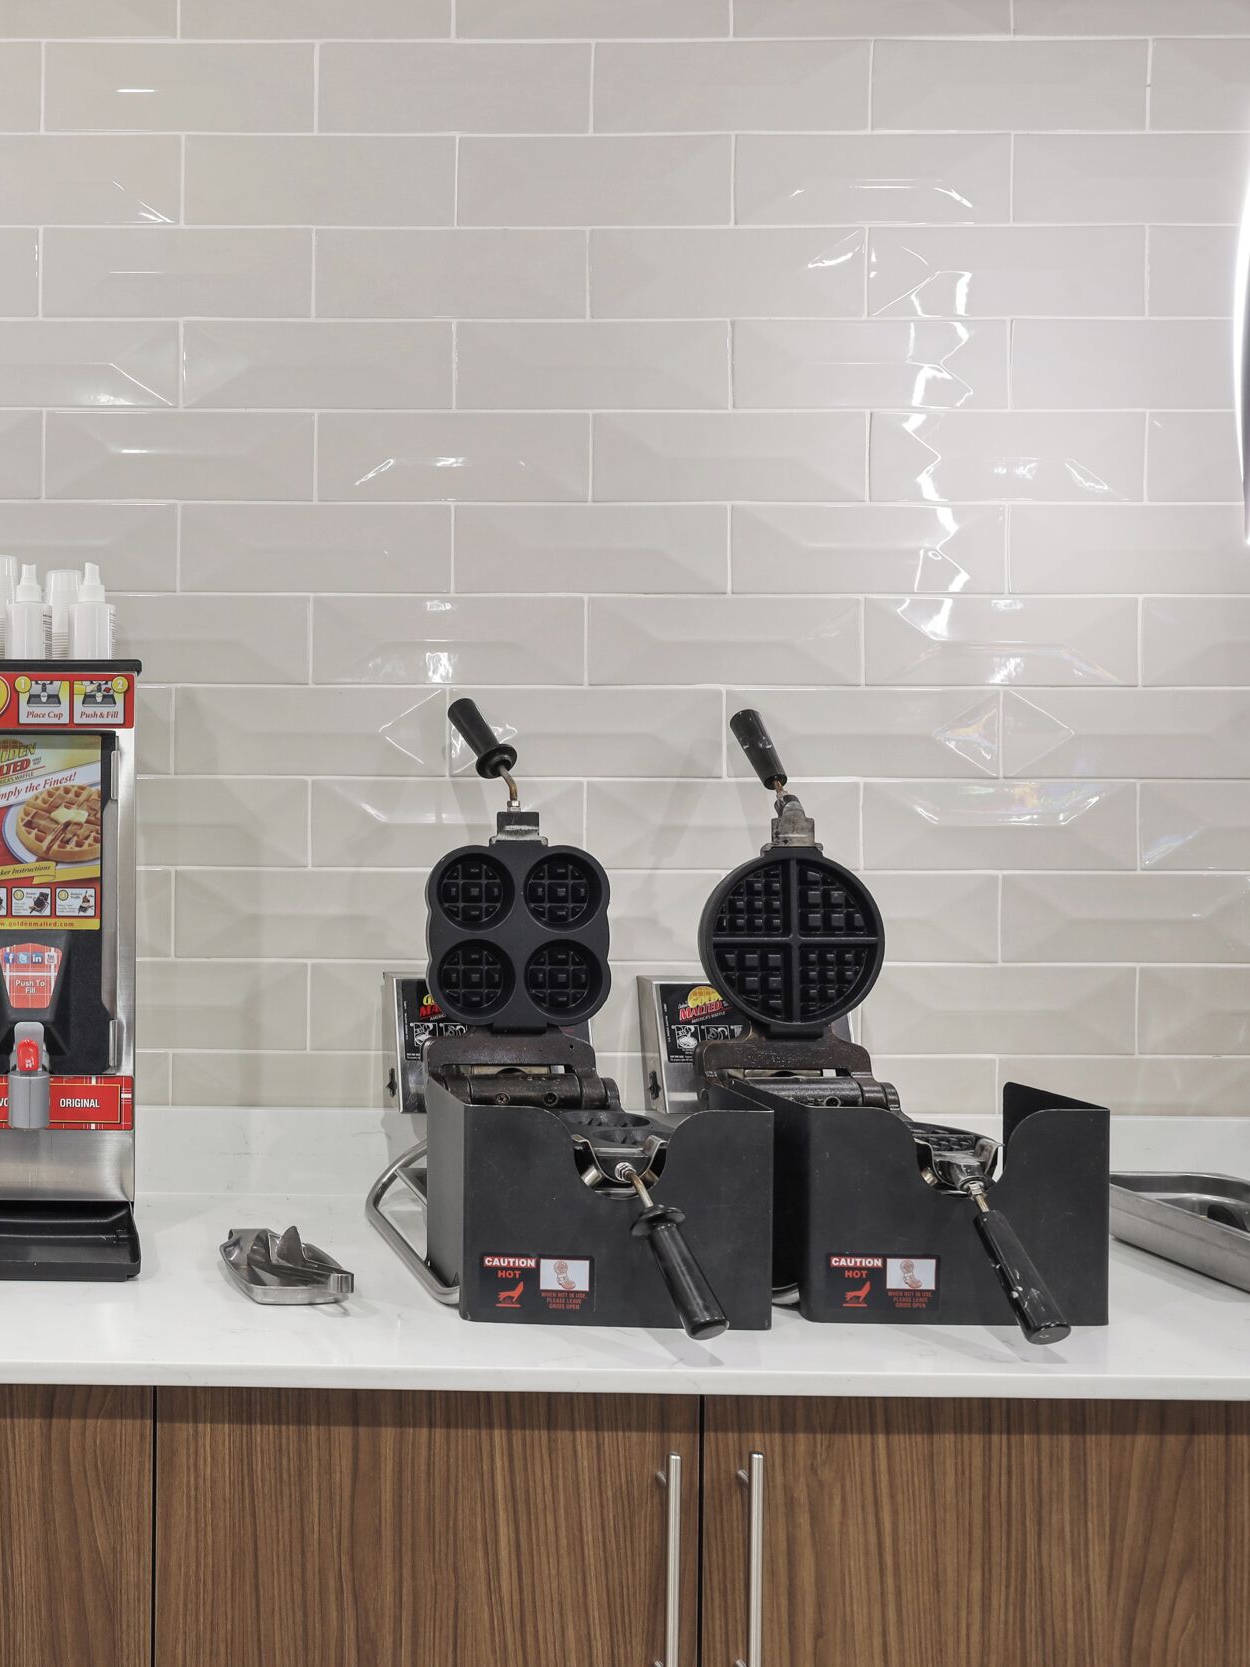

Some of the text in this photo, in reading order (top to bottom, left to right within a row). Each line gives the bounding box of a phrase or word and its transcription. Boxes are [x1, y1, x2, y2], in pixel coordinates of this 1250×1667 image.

[20, 678, 26, 689] 1
[117, 679, 124, 689] 2
[26, 710, 64, 720] Place Cup
[79, 710, 119, 719] Push & Fill
[15, 771, 34, 782] WAFFLE
[24, 782, 41, 794] the
[42, 771, 77, 789] Finest!
[11, 864, 51, 875] Instructions
[15, 979, 45, 987] Push To
[25, 987, 36, 995] Fill
[679, 1000, 723, 1021] MALTED
[59, 1098, 101, 1108] ORIGINAL
[484, 1257, 535, 1267] CAUTION
[831, 1257, 882, 1267] CAUTION
[497, 1270, 522, 1279] HOT
[844, 1270, 869, 1279] HOT
